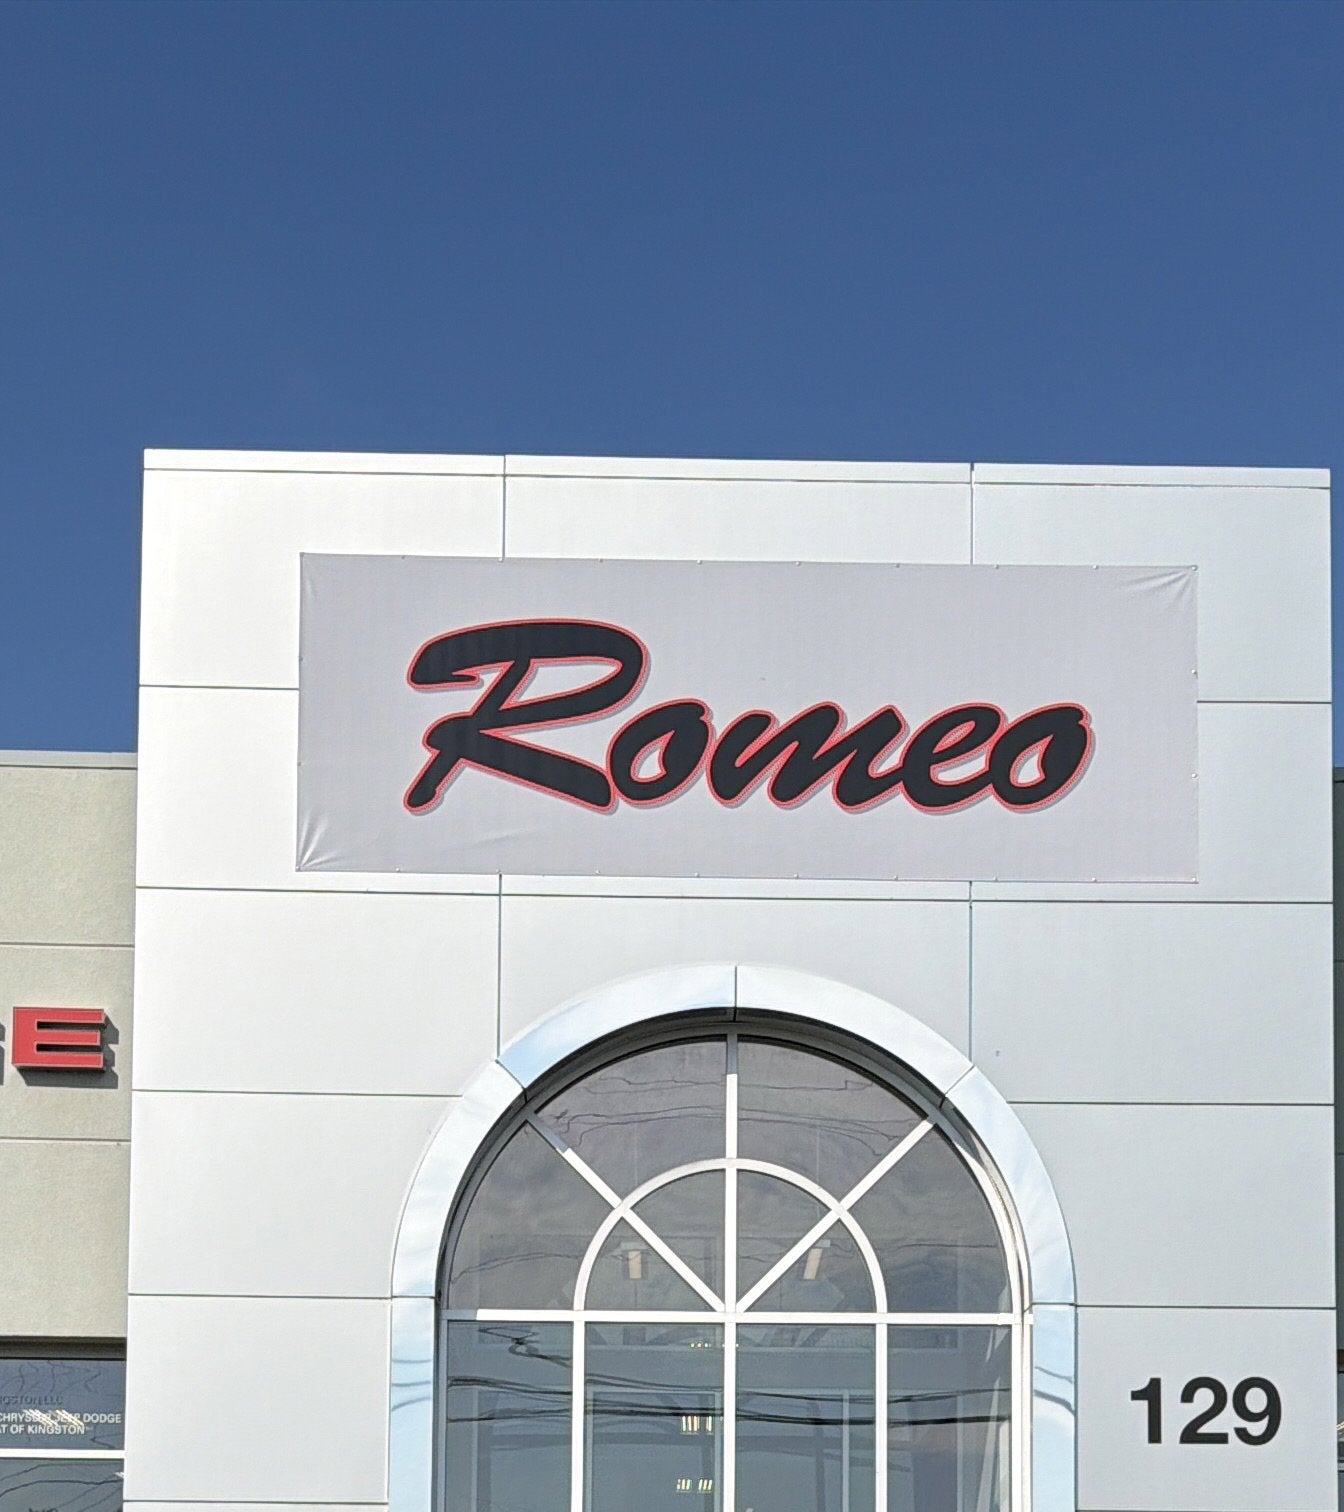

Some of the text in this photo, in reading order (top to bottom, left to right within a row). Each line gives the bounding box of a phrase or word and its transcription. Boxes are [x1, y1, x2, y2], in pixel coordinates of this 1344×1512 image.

[406, 618, 1092, 812] Romeo
[9, 1424, 25, 1434] OF
[27, 1424, 85, 1435] KINGSTON
[82, 1413, 122, 1424] DODGE
[1130, 1376, 1282, 1446] 129
